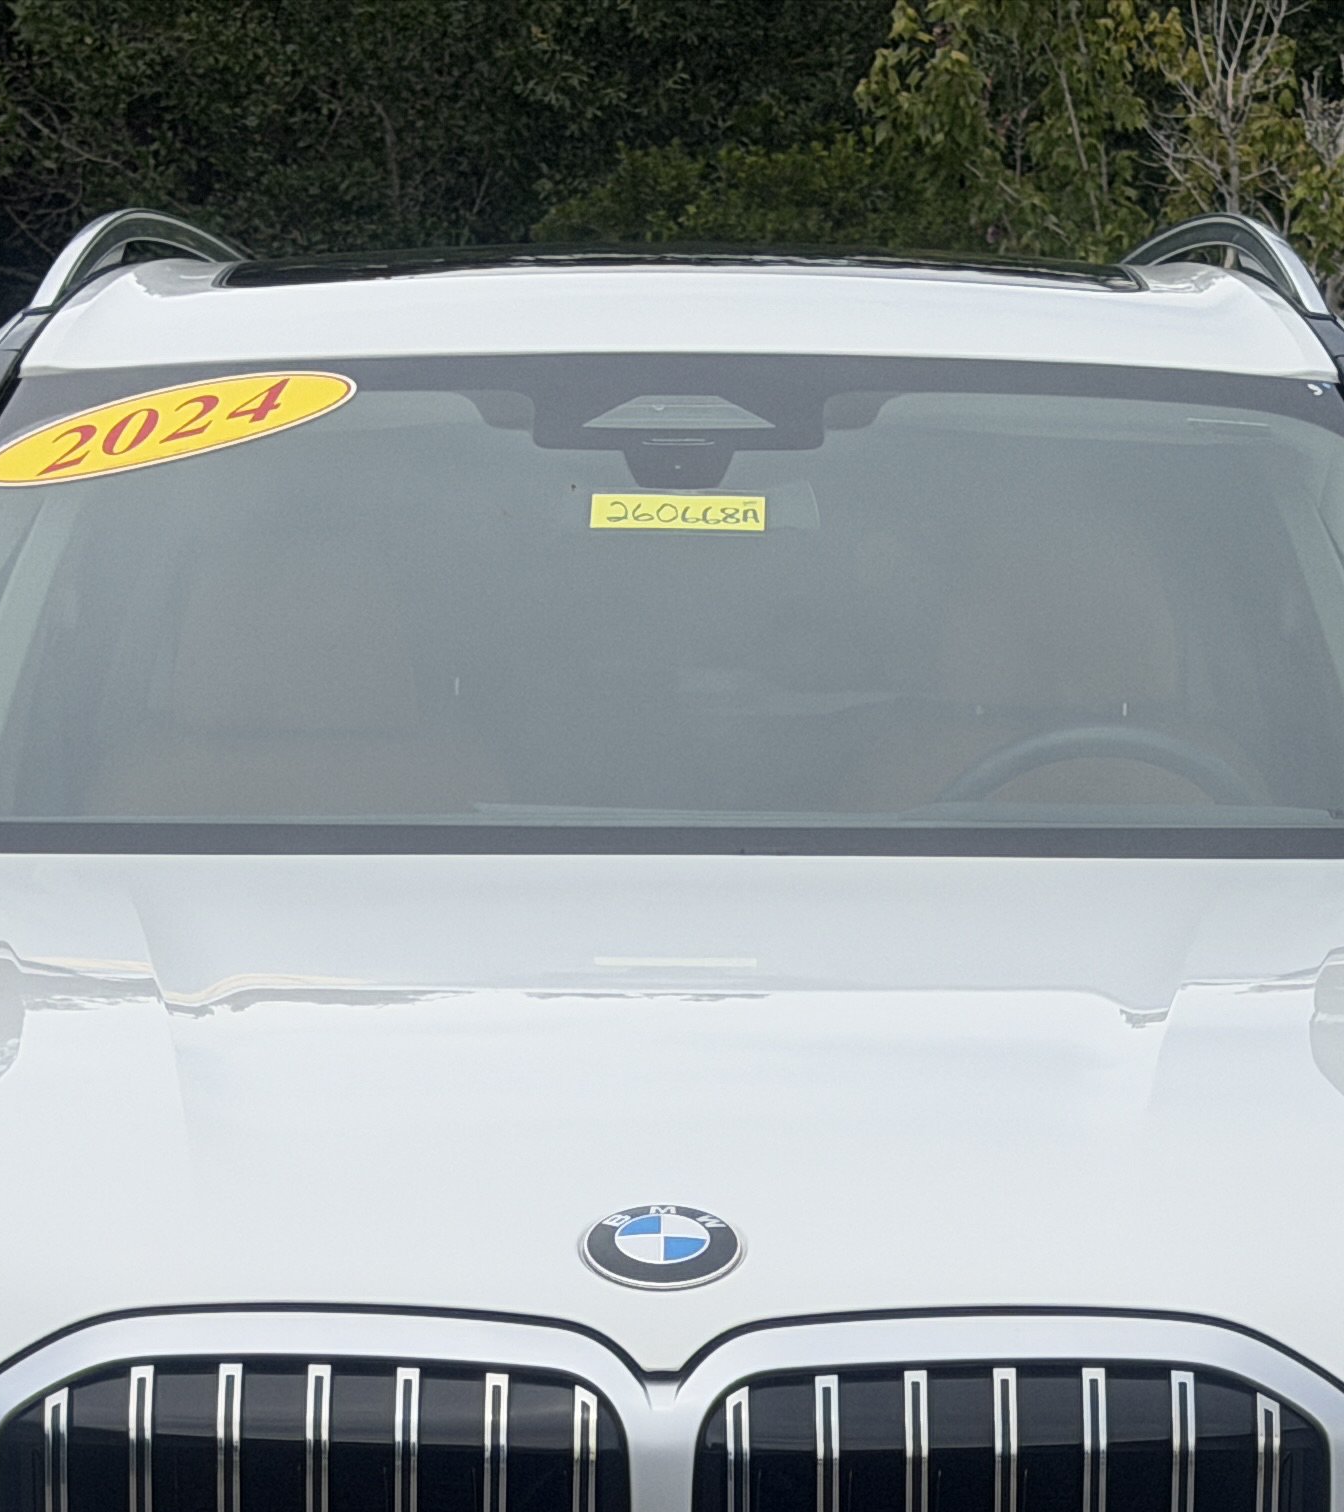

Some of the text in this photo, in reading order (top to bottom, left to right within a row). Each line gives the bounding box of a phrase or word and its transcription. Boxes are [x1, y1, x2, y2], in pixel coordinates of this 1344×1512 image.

[36, 377, 291, 476] 2024
[606, 501, 760, 525] 260668A
[602, 1206, 727, 1228] BMW
